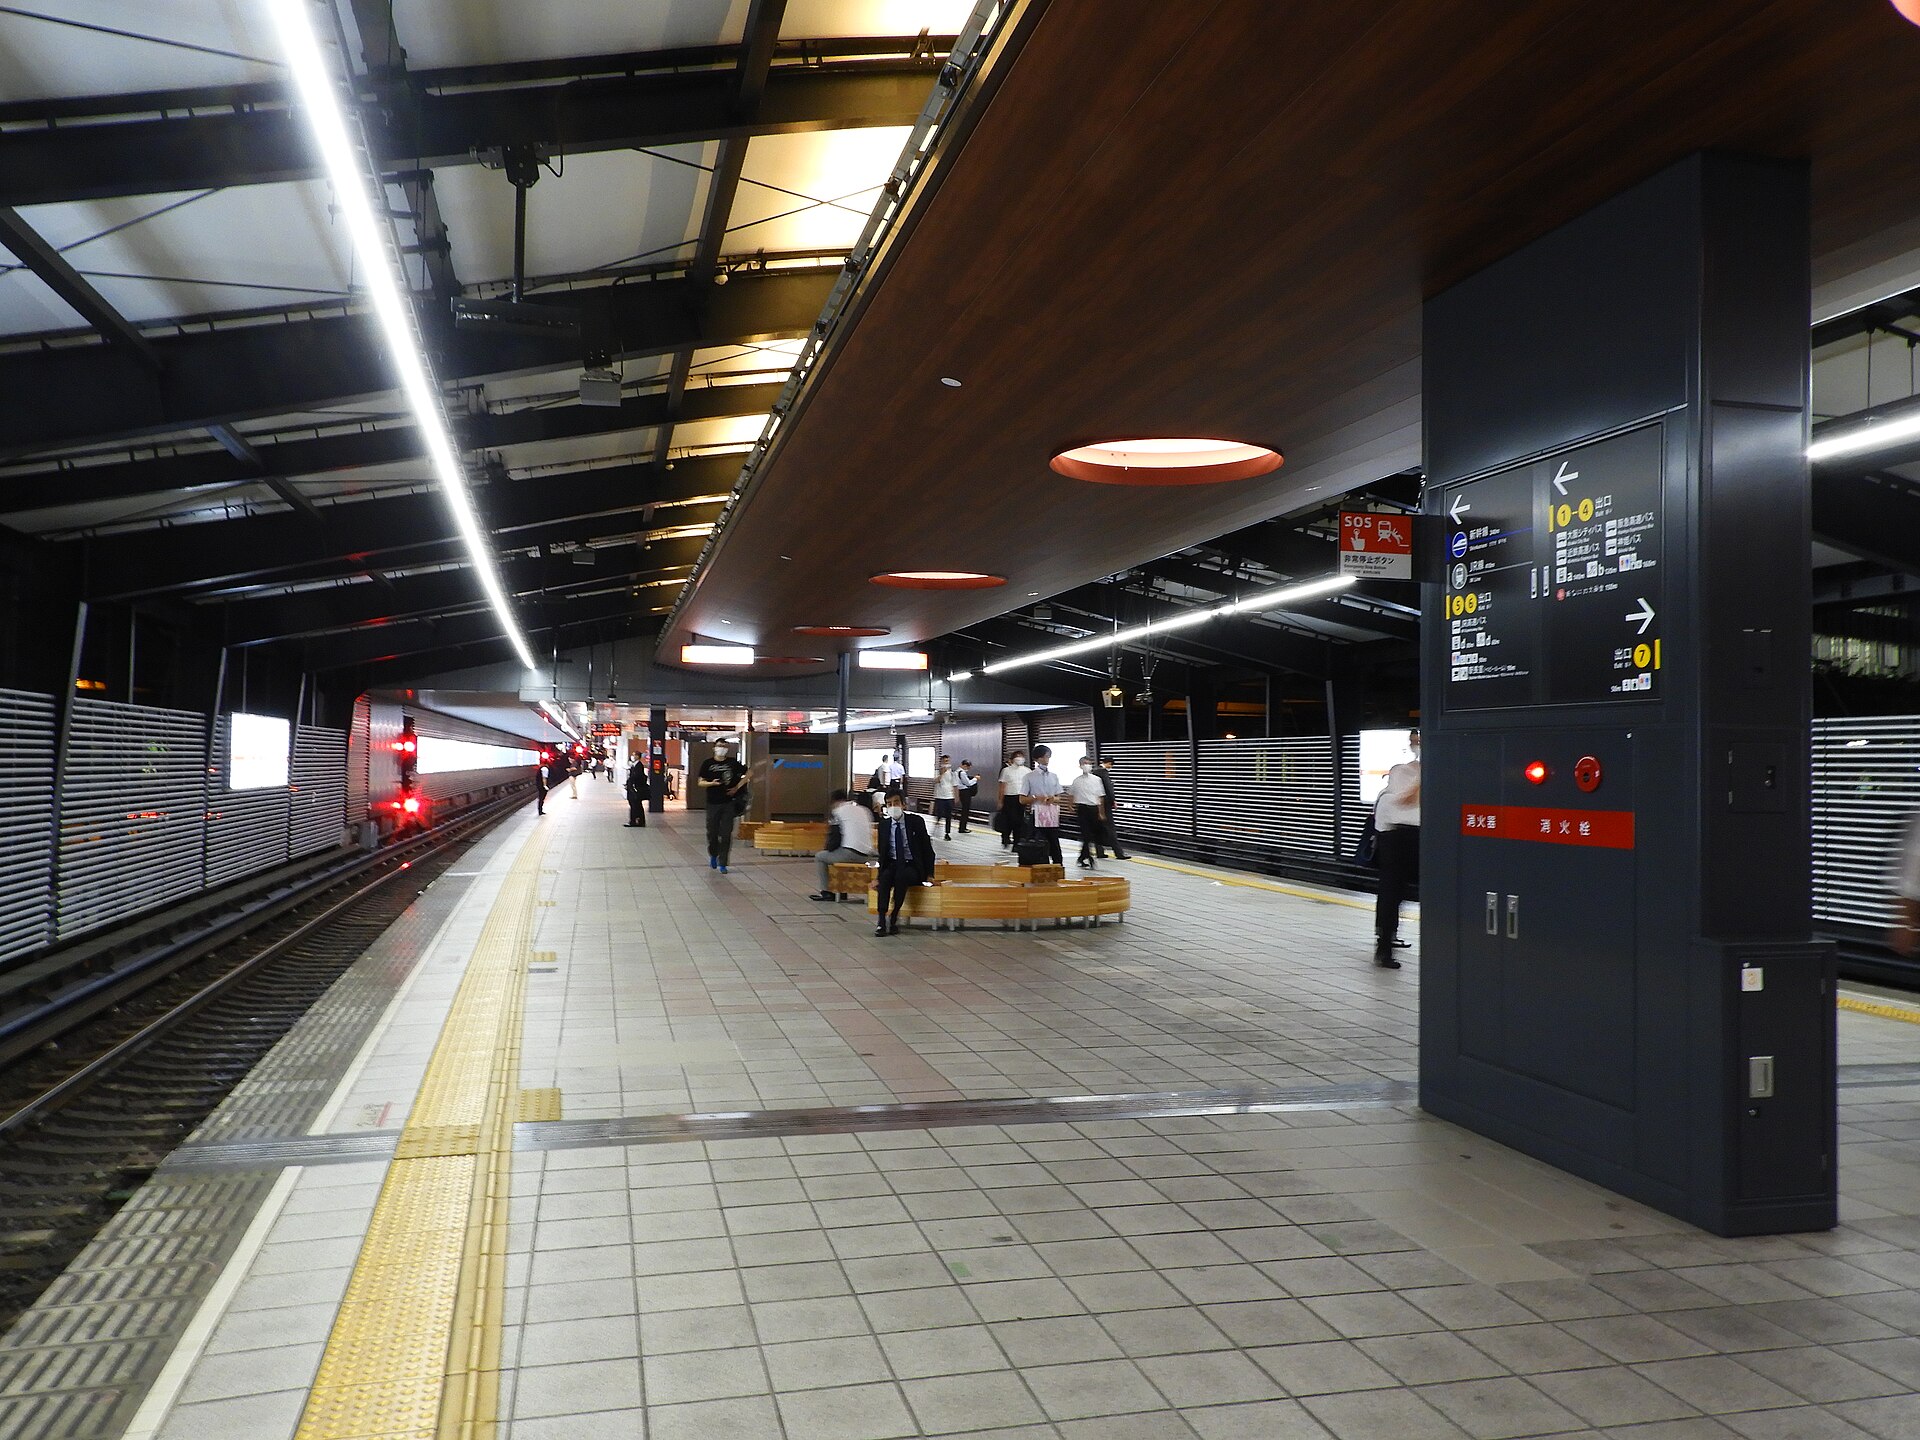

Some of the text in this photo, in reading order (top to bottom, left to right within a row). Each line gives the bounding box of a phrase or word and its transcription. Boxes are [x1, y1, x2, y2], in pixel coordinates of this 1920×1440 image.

[1595, 495, 1612, 509] 出口
[1344, 516, 1372, 528] SOS
[1469, 526, 1489, 540] 新幹線
[1344, 555, 1395, 565] 非常停止ボタン
[1478, 592, 1492, 604] 出口
[1466, 813, 1497, 829] 消火器
[1540, 818, 1591, 836] 消火栓
